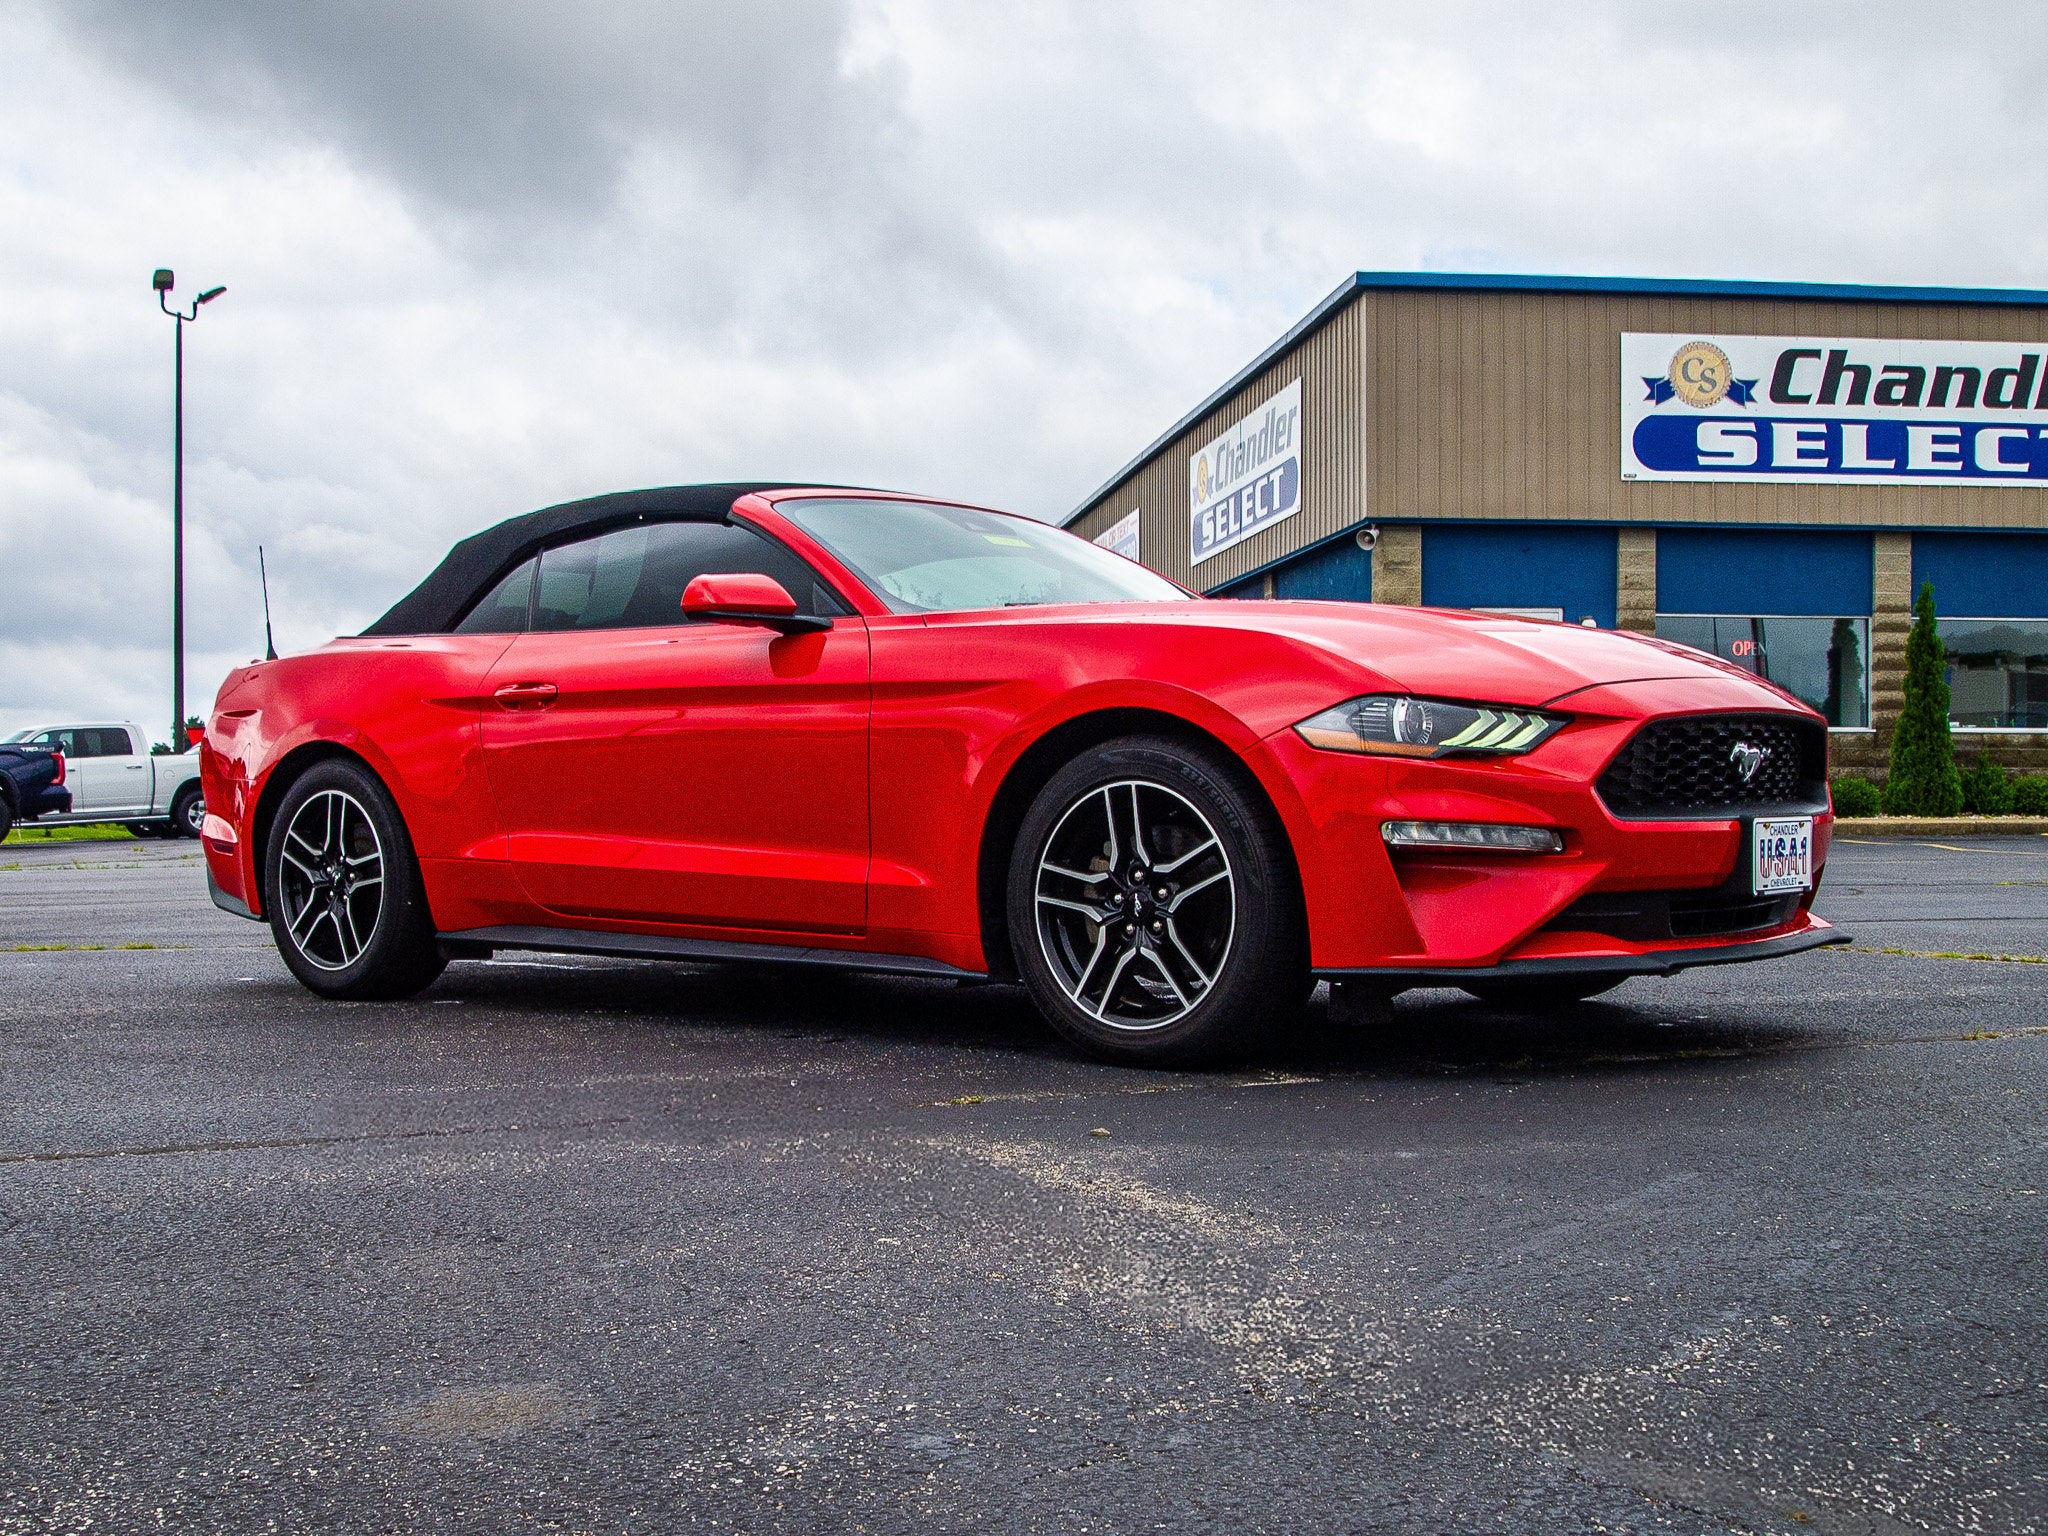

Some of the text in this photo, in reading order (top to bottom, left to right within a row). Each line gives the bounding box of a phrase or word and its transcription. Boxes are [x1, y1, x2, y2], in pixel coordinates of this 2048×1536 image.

[1215, 405, 1298, 493] Chandler
[1697, 421, 2048, 473] SELEC
[1202, 466, 1284, 549] SELECT
[1770, 824, 1799, 836] CHANDLER
